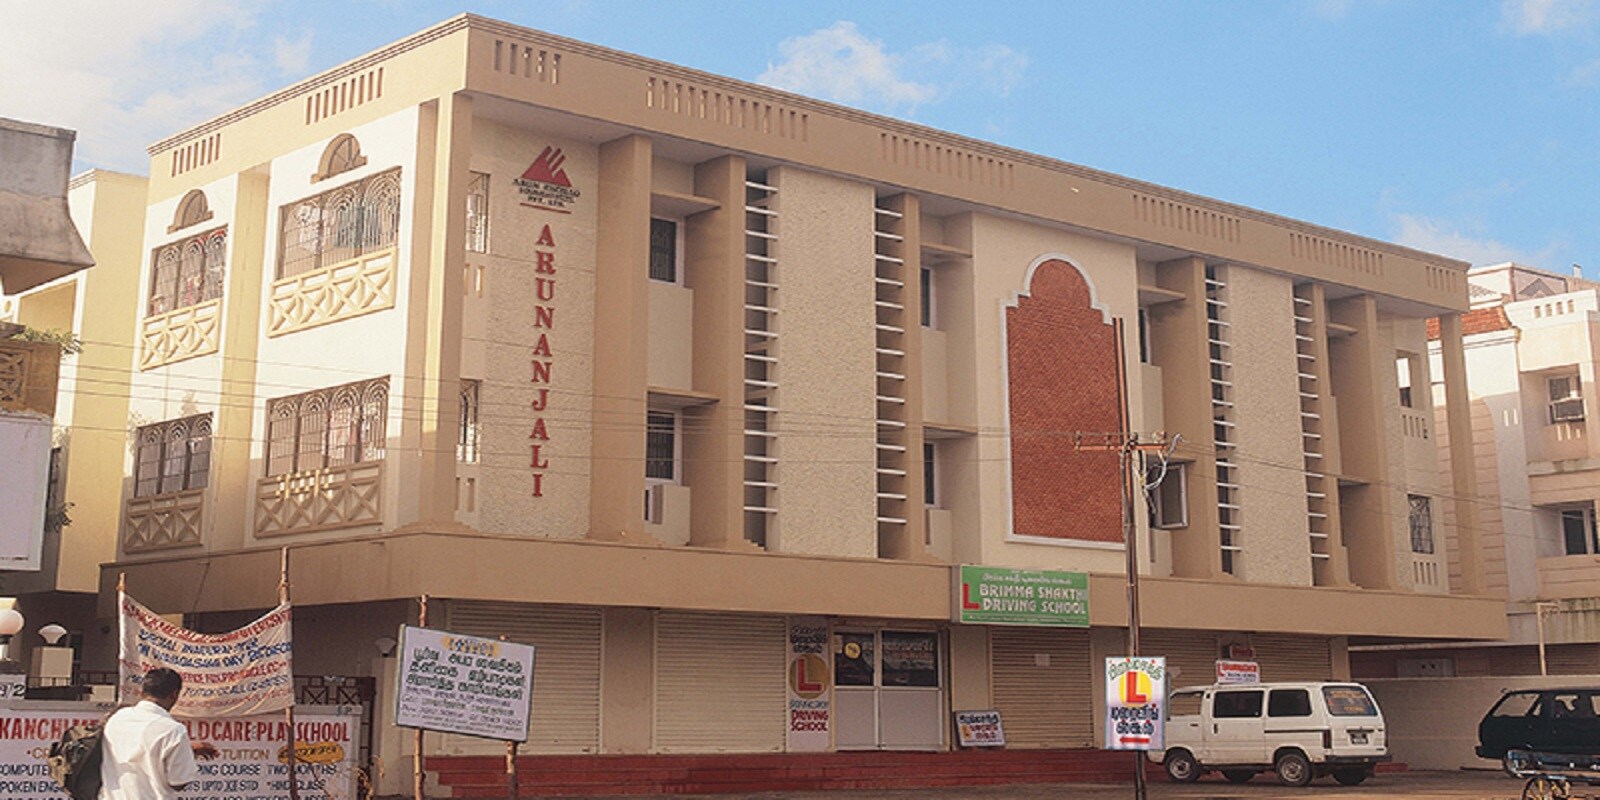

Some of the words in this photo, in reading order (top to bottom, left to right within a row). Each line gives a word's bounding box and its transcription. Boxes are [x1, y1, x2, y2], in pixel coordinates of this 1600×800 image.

[528, 224, 556, 498] ARUNANJALI
[962, 583, 980, 610] L
[982, 598, 1037, 613] DRIVING
[1041, 600, 1087, 615] SCHOOL
[798, 659, 822, 692] L
[1126, 671, 1147, 703] L
[296, 721, 350, 742] SCHOOL
[0, 764, 49, 776] OMPUTE
[221, 764, 261, 776] COURSE
[0, 780, 36, 793] POKEN
